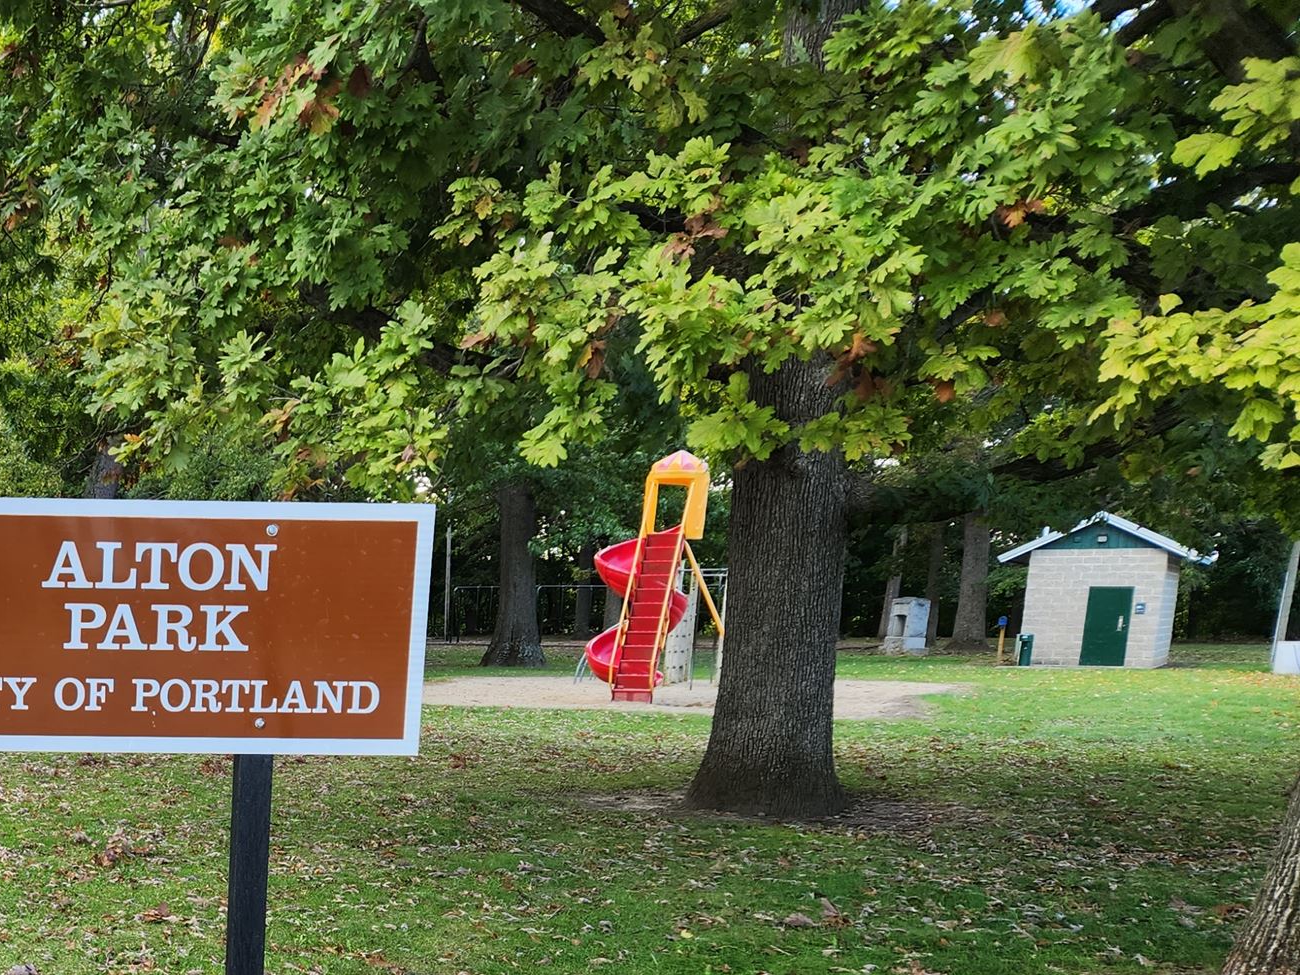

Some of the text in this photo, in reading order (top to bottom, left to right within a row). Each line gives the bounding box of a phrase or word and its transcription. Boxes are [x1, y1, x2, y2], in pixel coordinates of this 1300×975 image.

[41, 540, 278, 592] ALTON
[62, 602, 249, 652] PARK
[53, 677, 115, 712] OF
[130, 678, 381, 714] PORTLAND
